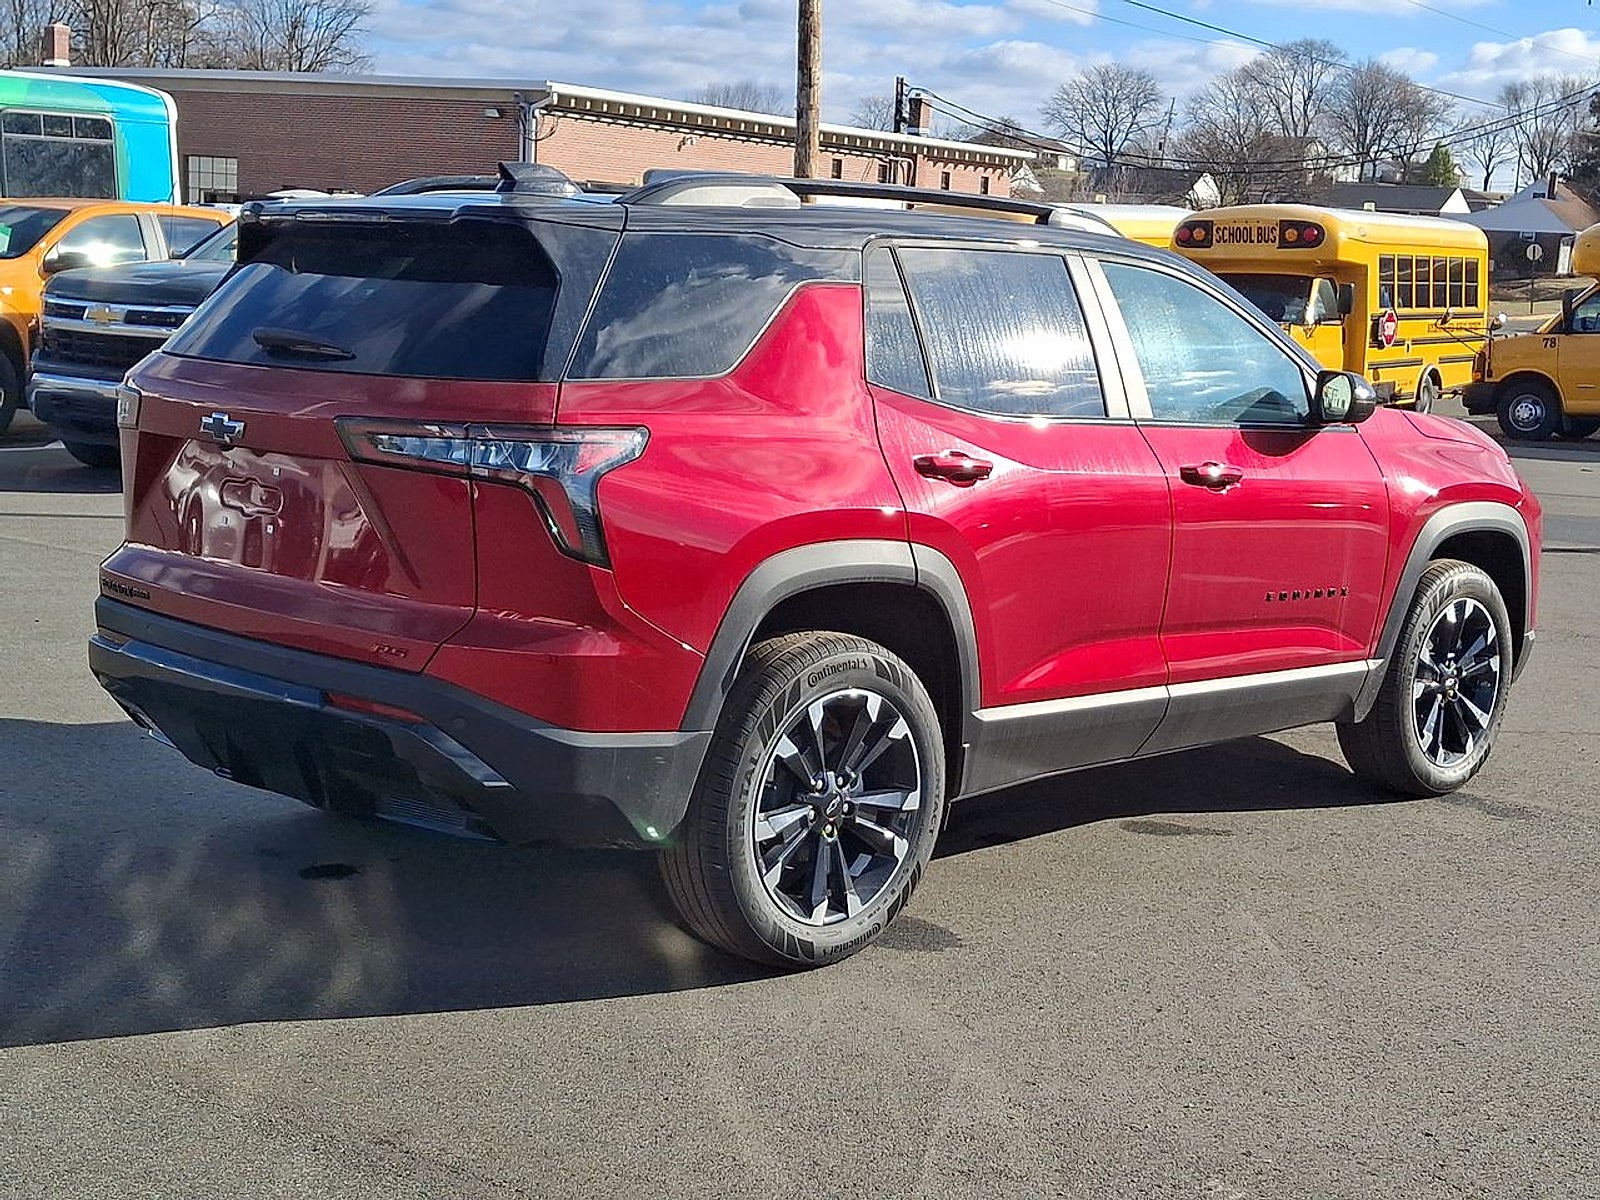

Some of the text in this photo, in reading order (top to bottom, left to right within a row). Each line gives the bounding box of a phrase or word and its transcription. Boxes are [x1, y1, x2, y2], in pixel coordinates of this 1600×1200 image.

[1215, 226, 1277, 244] SCHOOL BUS
[1542, 337, 1557, 349] 78
[807, 657, 860, 688] Continental
